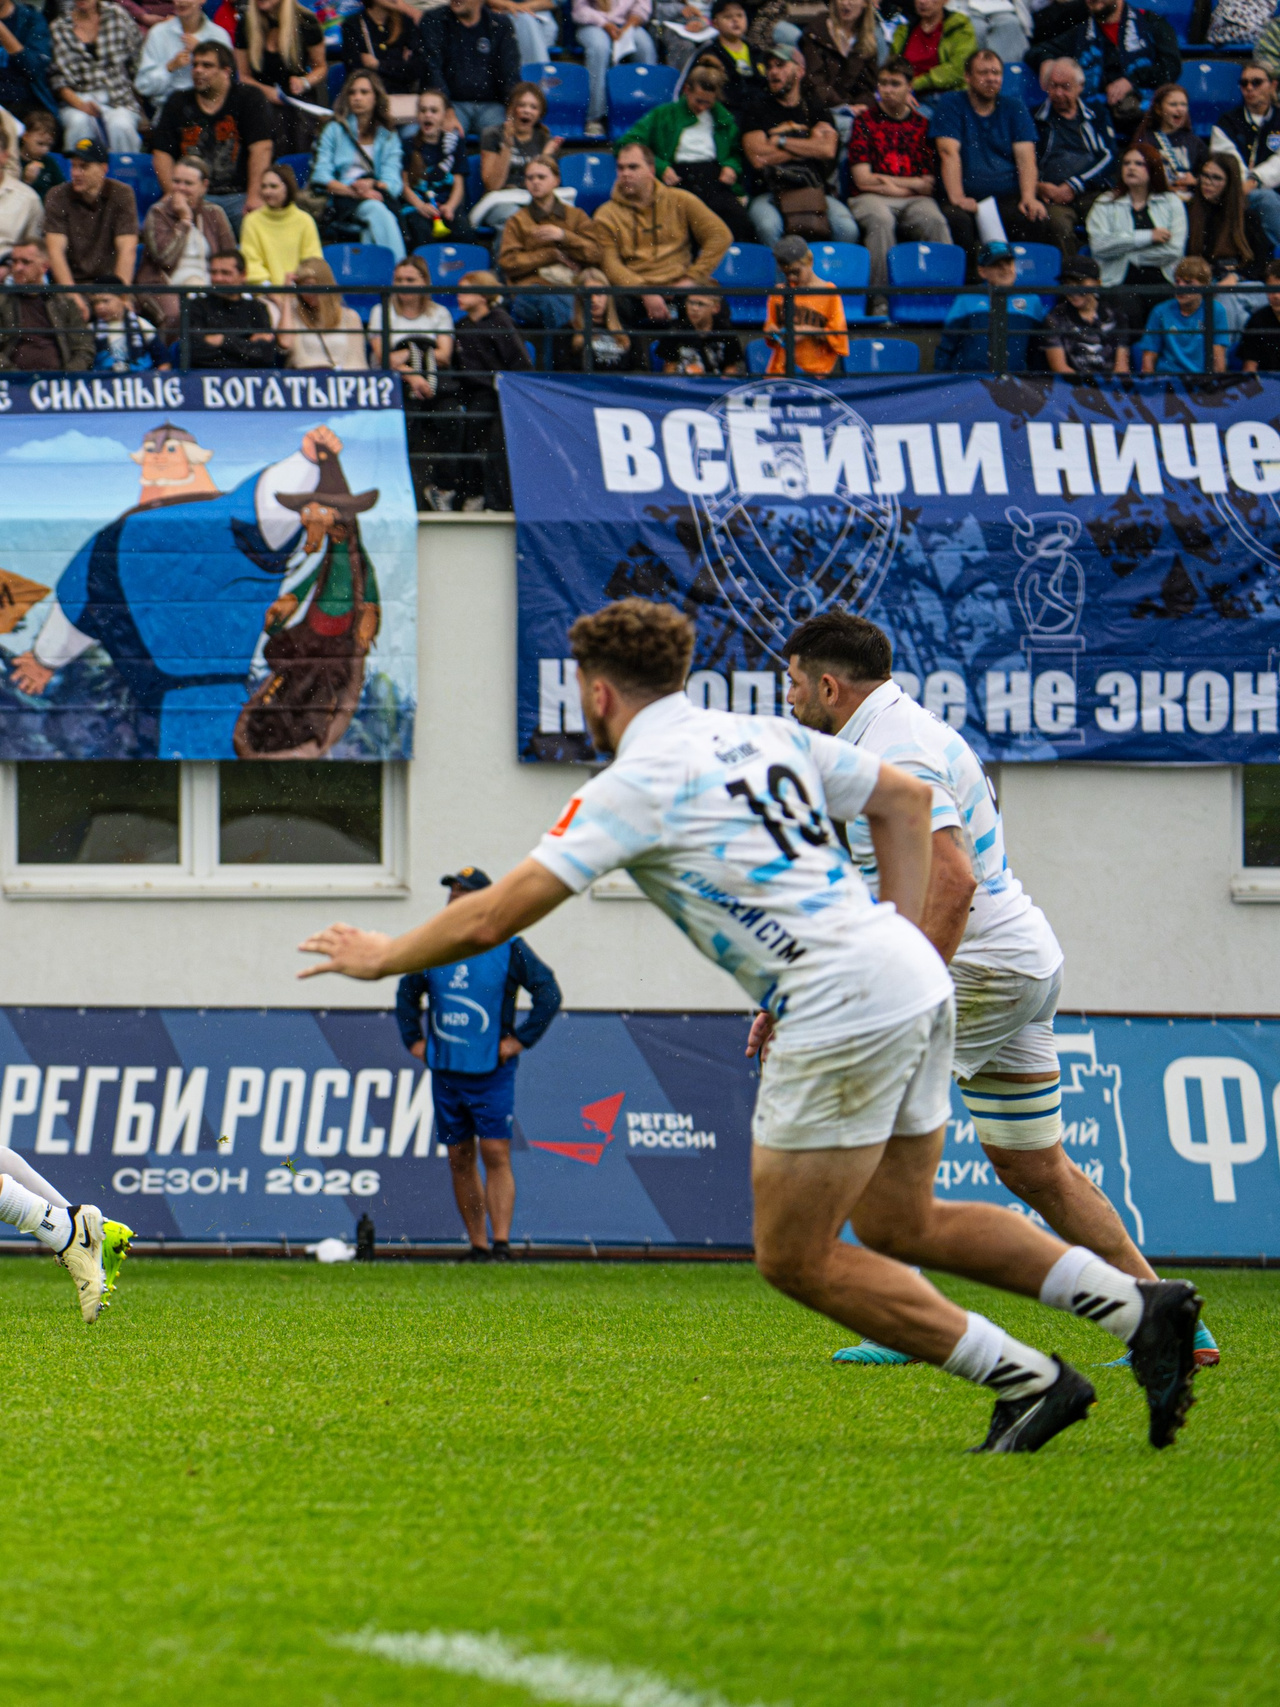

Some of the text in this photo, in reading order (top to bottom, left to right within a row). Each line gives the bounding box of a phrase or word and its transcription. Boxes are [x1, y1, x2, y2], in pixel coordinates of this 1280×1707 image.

[29, 376, 184, 411] СИЛЬНЫЕ
[201, 376, 394, 408] БОГАТЫРИ?
[218, 1066, 449, 1158] РОССИ
[626, 1112, 695, 1131] РЕГБИ
[628, 1130, 717, 1150] РОССИИ
[1163, 1056, 1280, 1203] Ф
[112, 1168, 381, 1196] СЕЗОН 2026
